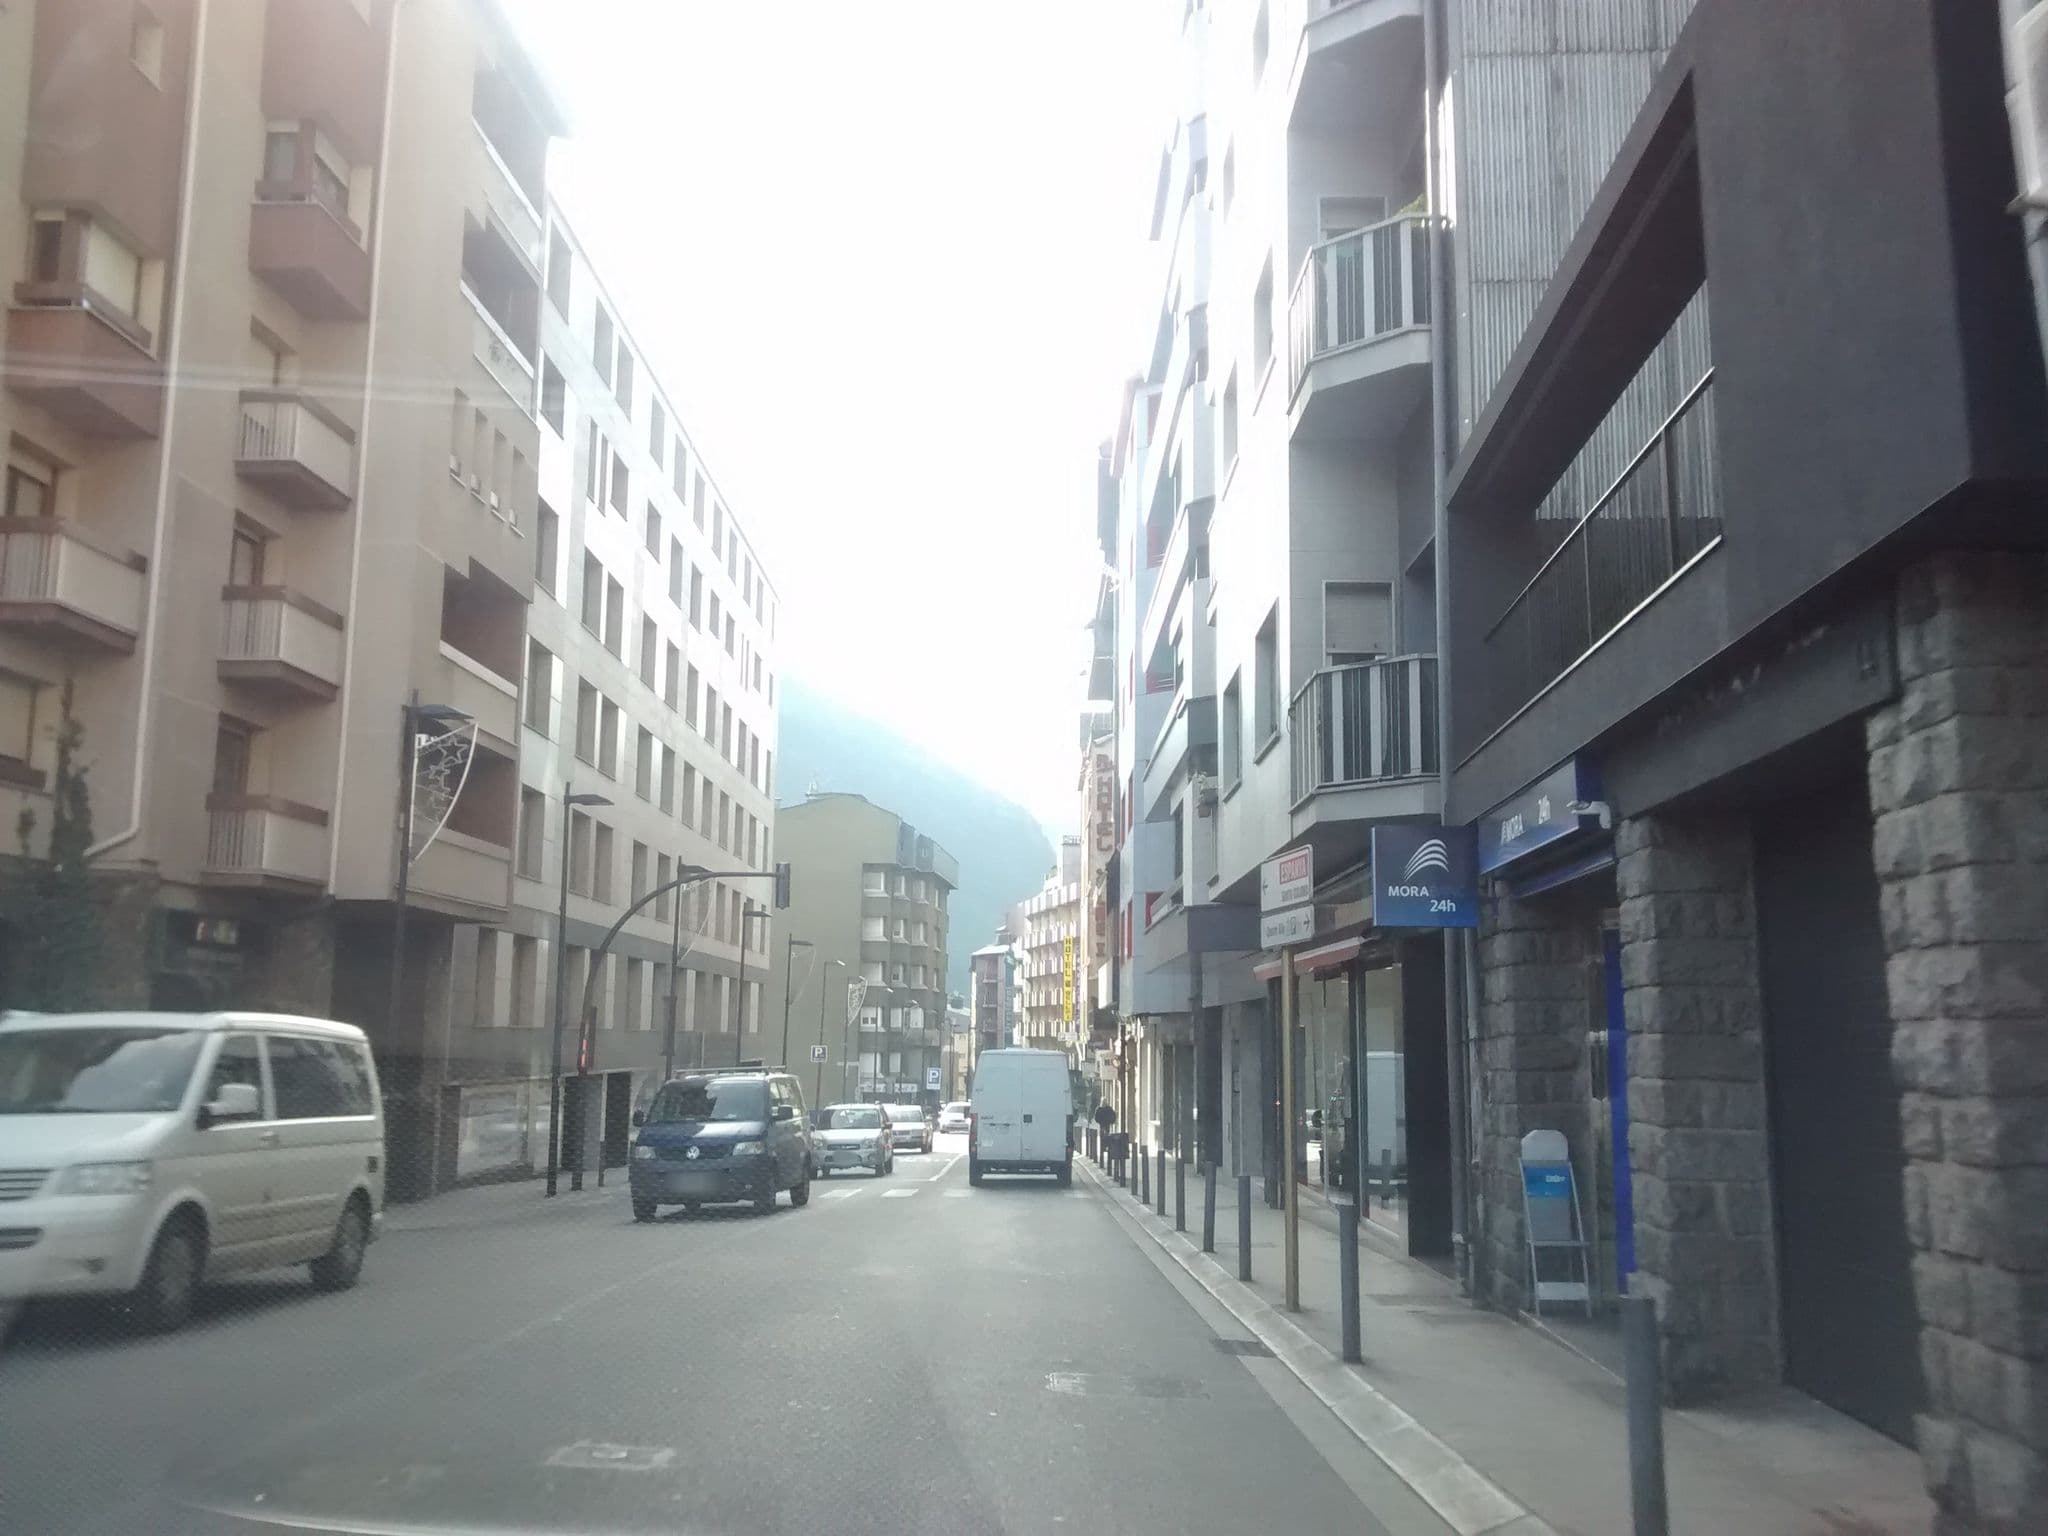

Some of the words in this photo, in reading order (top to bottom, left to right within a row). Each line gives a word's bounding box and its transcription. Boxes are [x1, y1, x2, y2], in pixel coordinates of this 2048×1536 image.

[1388, 885, 1430, 897] MORA
[1430, 899, 1456, 912] 24h
[815, 1047, 823, 1058] P
[929, 1070, 939, 1082] P
